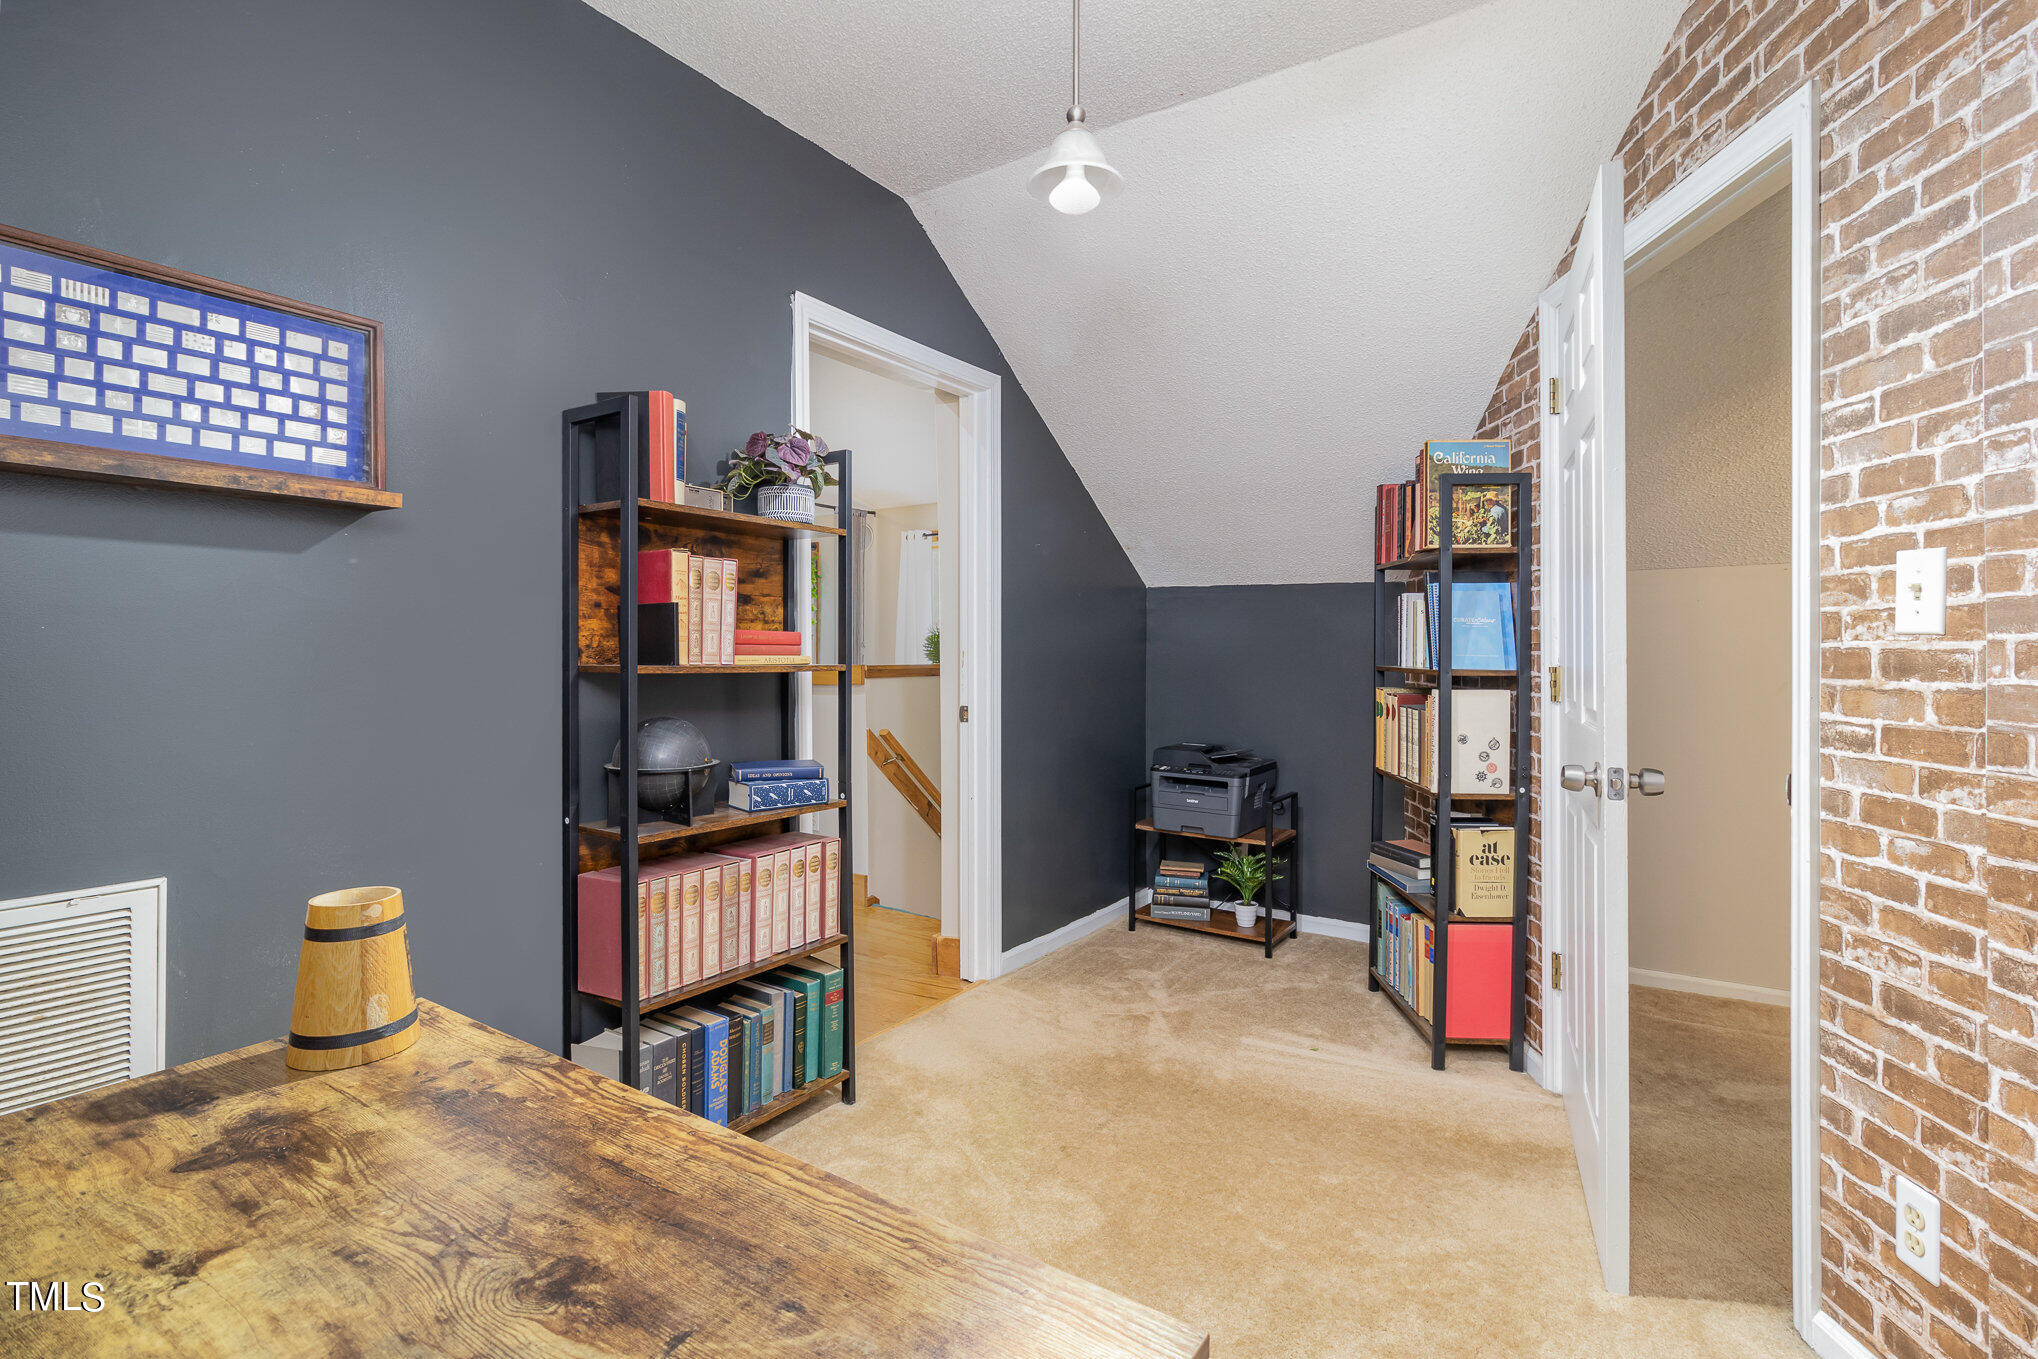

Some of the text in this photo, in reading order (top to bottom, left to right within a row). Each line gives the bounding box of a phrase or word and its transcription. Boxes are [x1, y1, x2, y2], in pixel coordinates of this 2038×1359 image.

[1433, 451, 1496, 464] California
[1481, 841, 1498, 854] at
[1469, 854, 1511, 866] ease
[1474, 884, 1498, 892] Dwight
[711, 1050, 720, 1090] ADAMS
[719, 1038, 728, 1092] DOUGLAS
